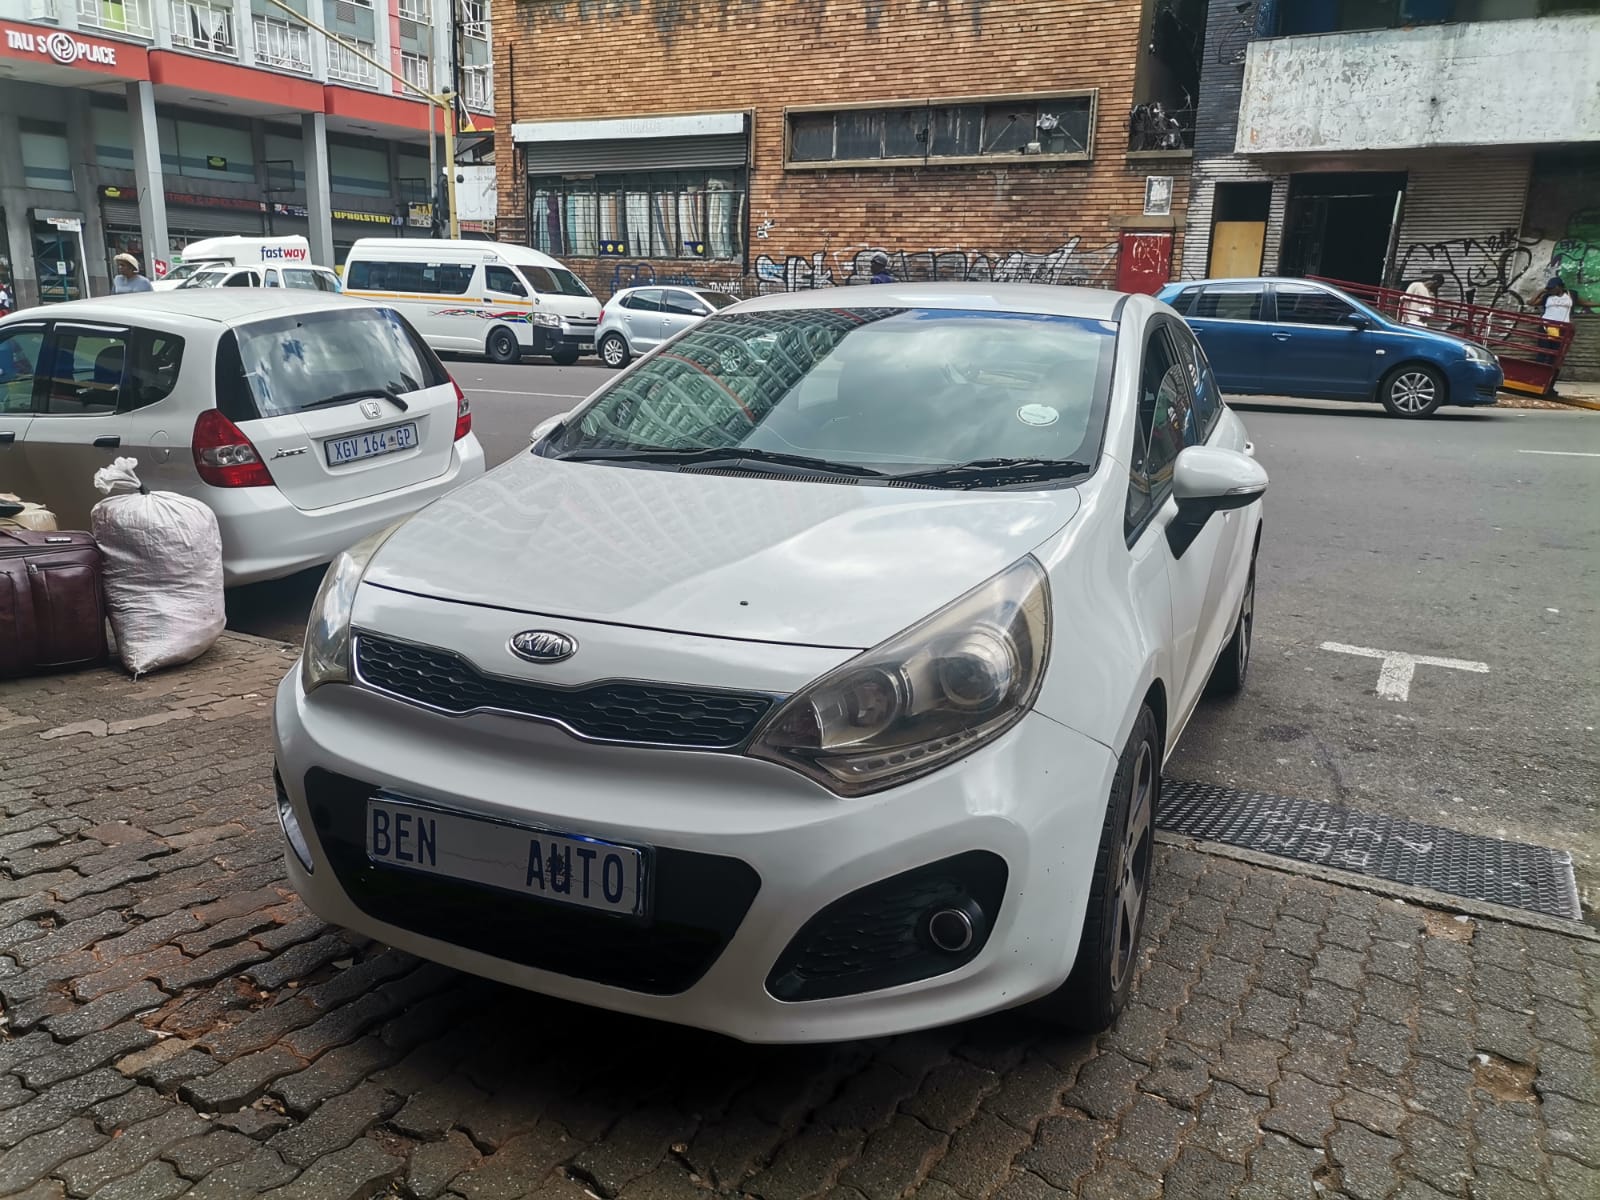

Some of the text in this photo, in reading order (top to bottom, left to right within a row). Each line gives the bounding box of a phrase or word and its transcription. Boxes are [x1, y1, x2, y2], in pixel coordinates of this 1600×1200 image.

[75, 42, 117, 65] PLACE
[333, 211, 391, 224] UPHOLSTERY
[261, 245, 306, 262] fastway
[334, 428, 411, 461] XGV 164 GP
[372, 808, 624, 904] BEN AUTO
